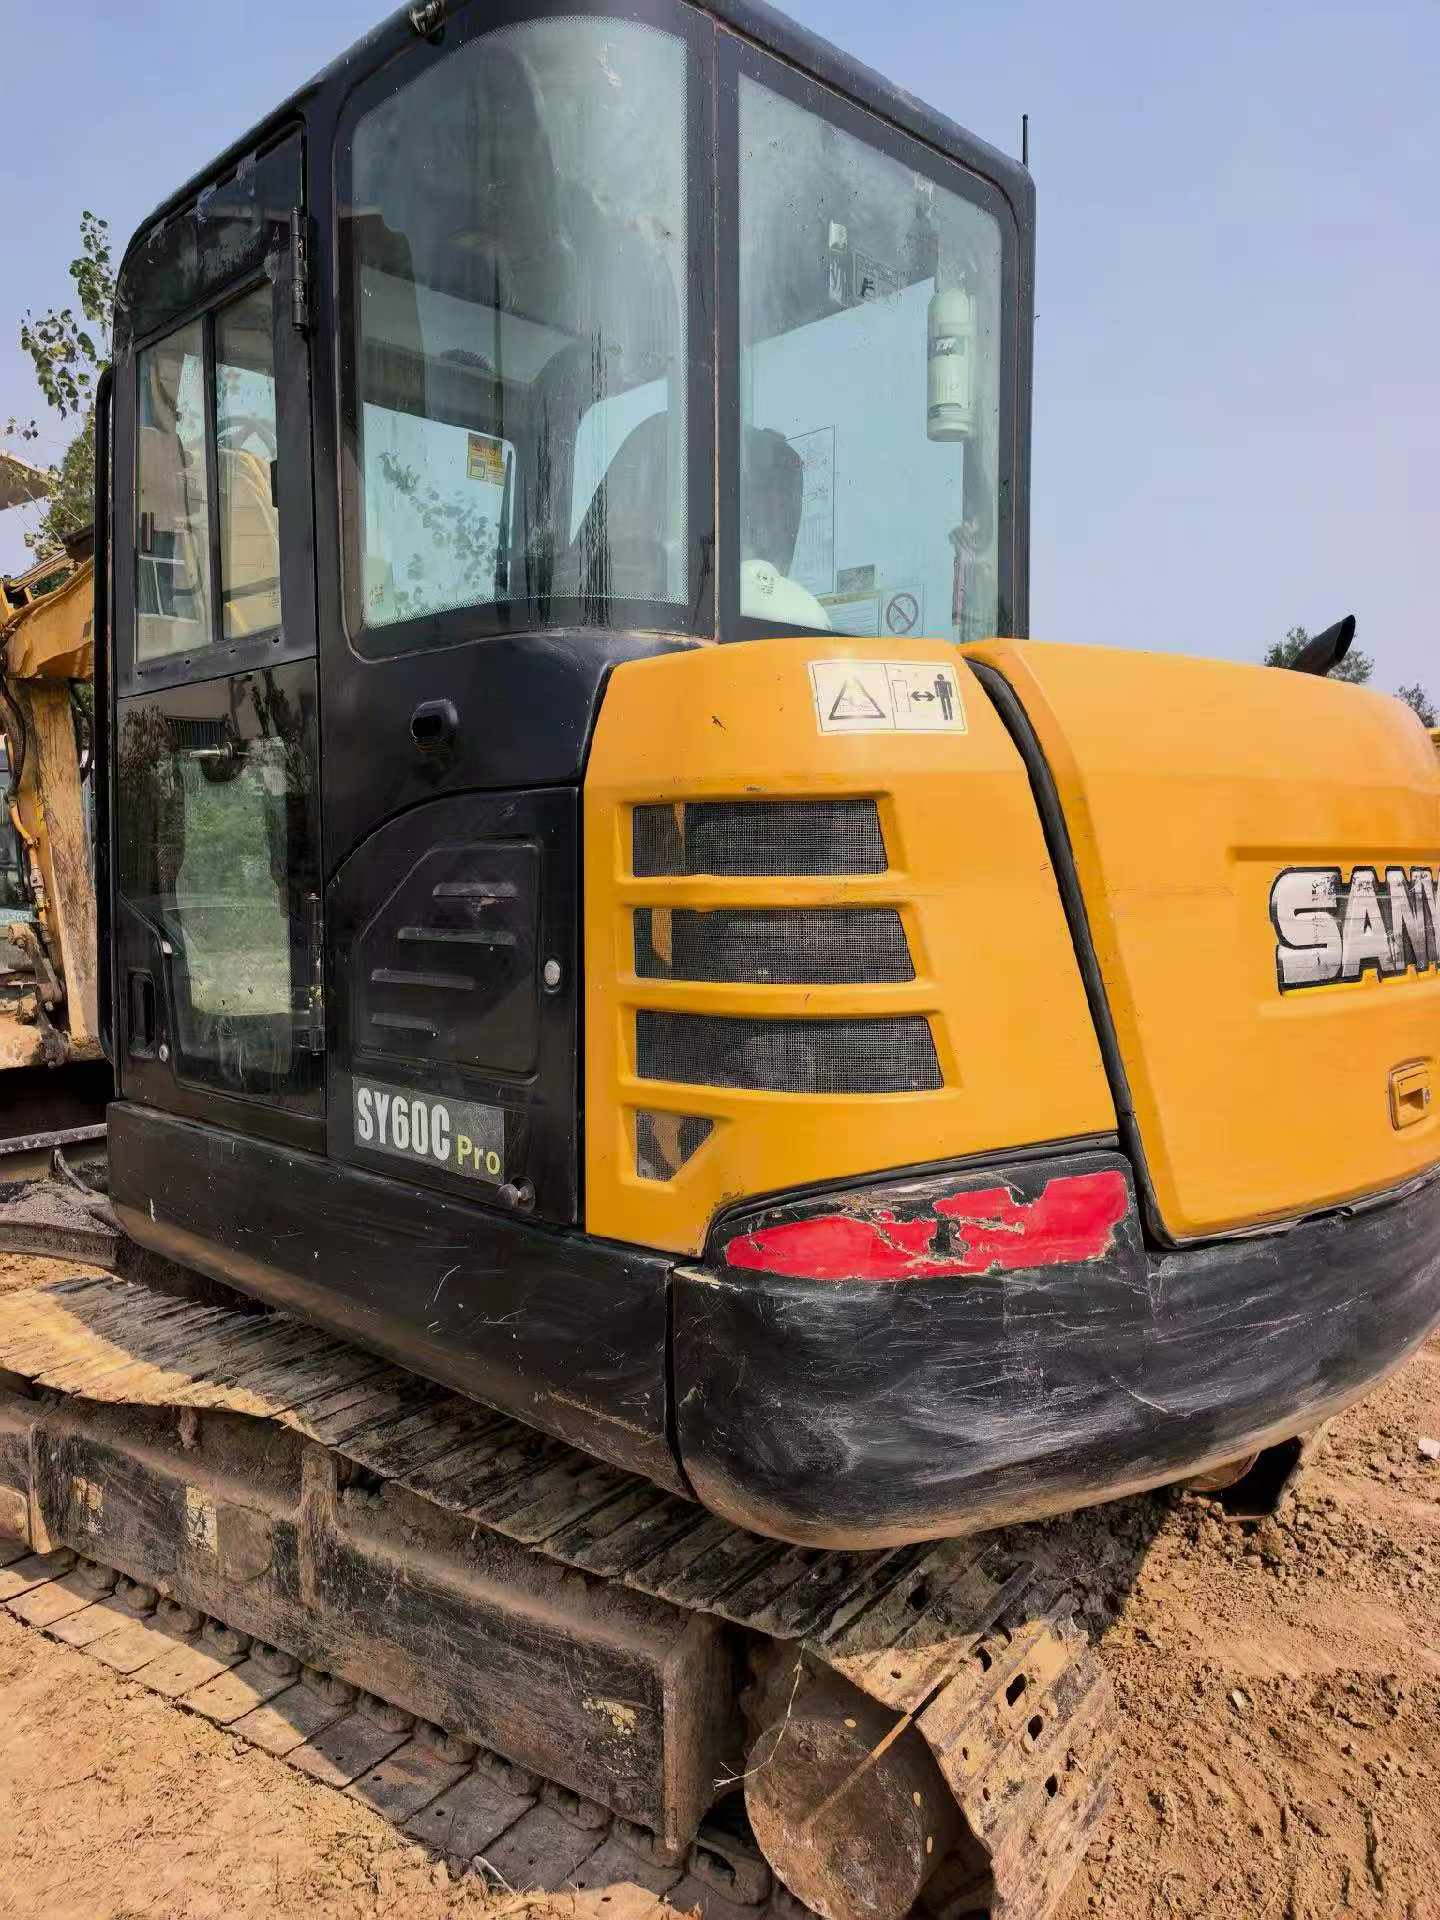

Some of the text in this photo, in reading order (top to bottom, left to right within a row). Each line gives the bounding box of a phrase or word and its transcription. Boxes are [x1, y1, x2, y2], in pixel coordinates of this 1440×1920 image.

[1270, 866, 1440, 992] SAN
[357, 1087, 501, 1175] SY60C Pro
